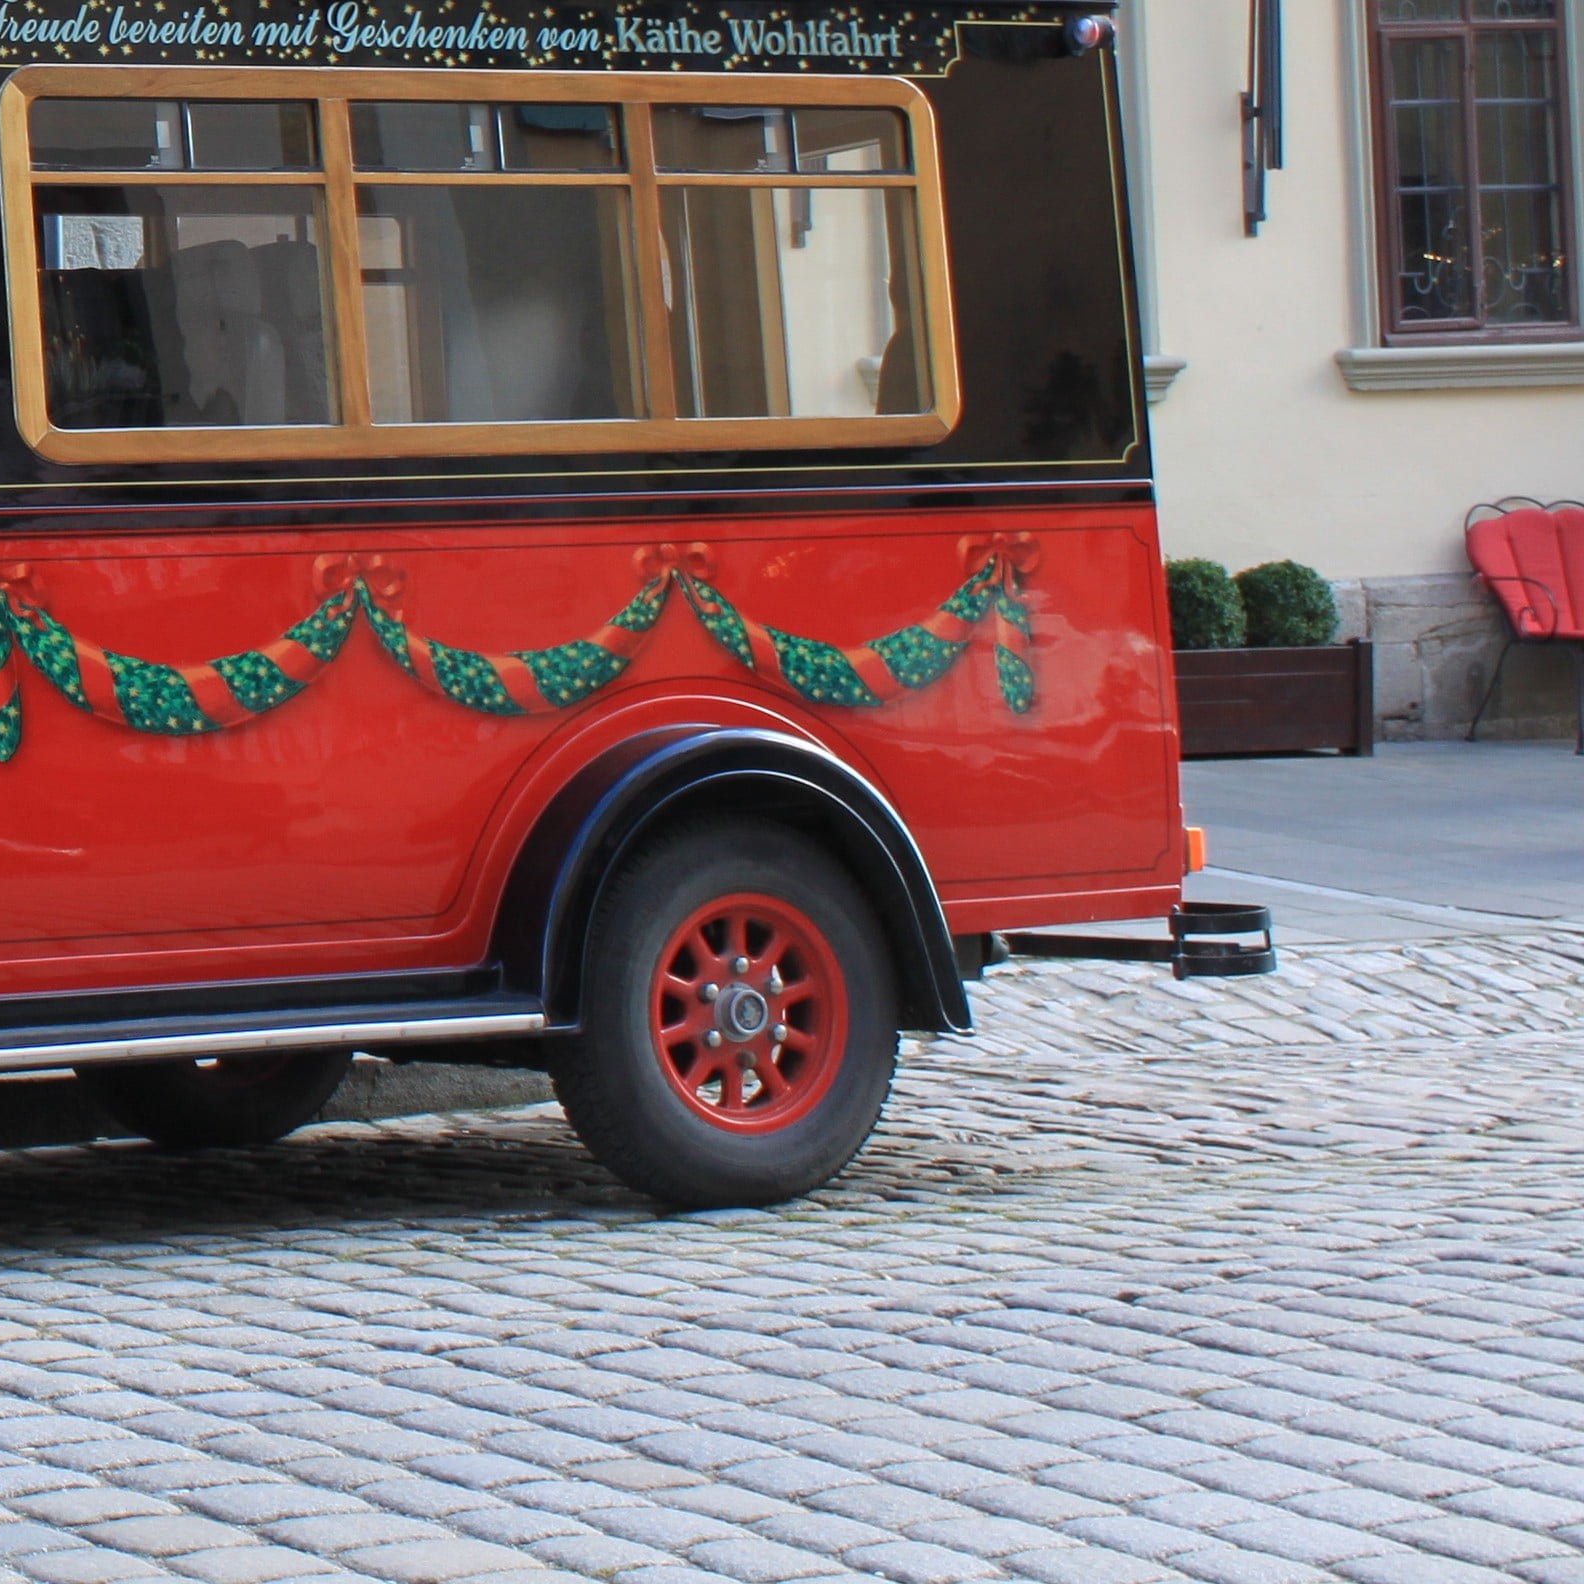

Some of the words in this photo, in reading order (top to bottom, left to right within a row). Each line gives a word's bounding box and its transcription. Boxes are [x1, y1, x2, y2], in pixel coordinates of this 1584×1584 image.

[108, 4, 246, 46] bereiten
[251, 7, 321, 48] mit
[325, 0, 530, 53] Geschenken
[536, 25, 601, 53] von
[613, 16, 723, 54] Käthe
[727, 18, 904, 58] Wohlfahrt
